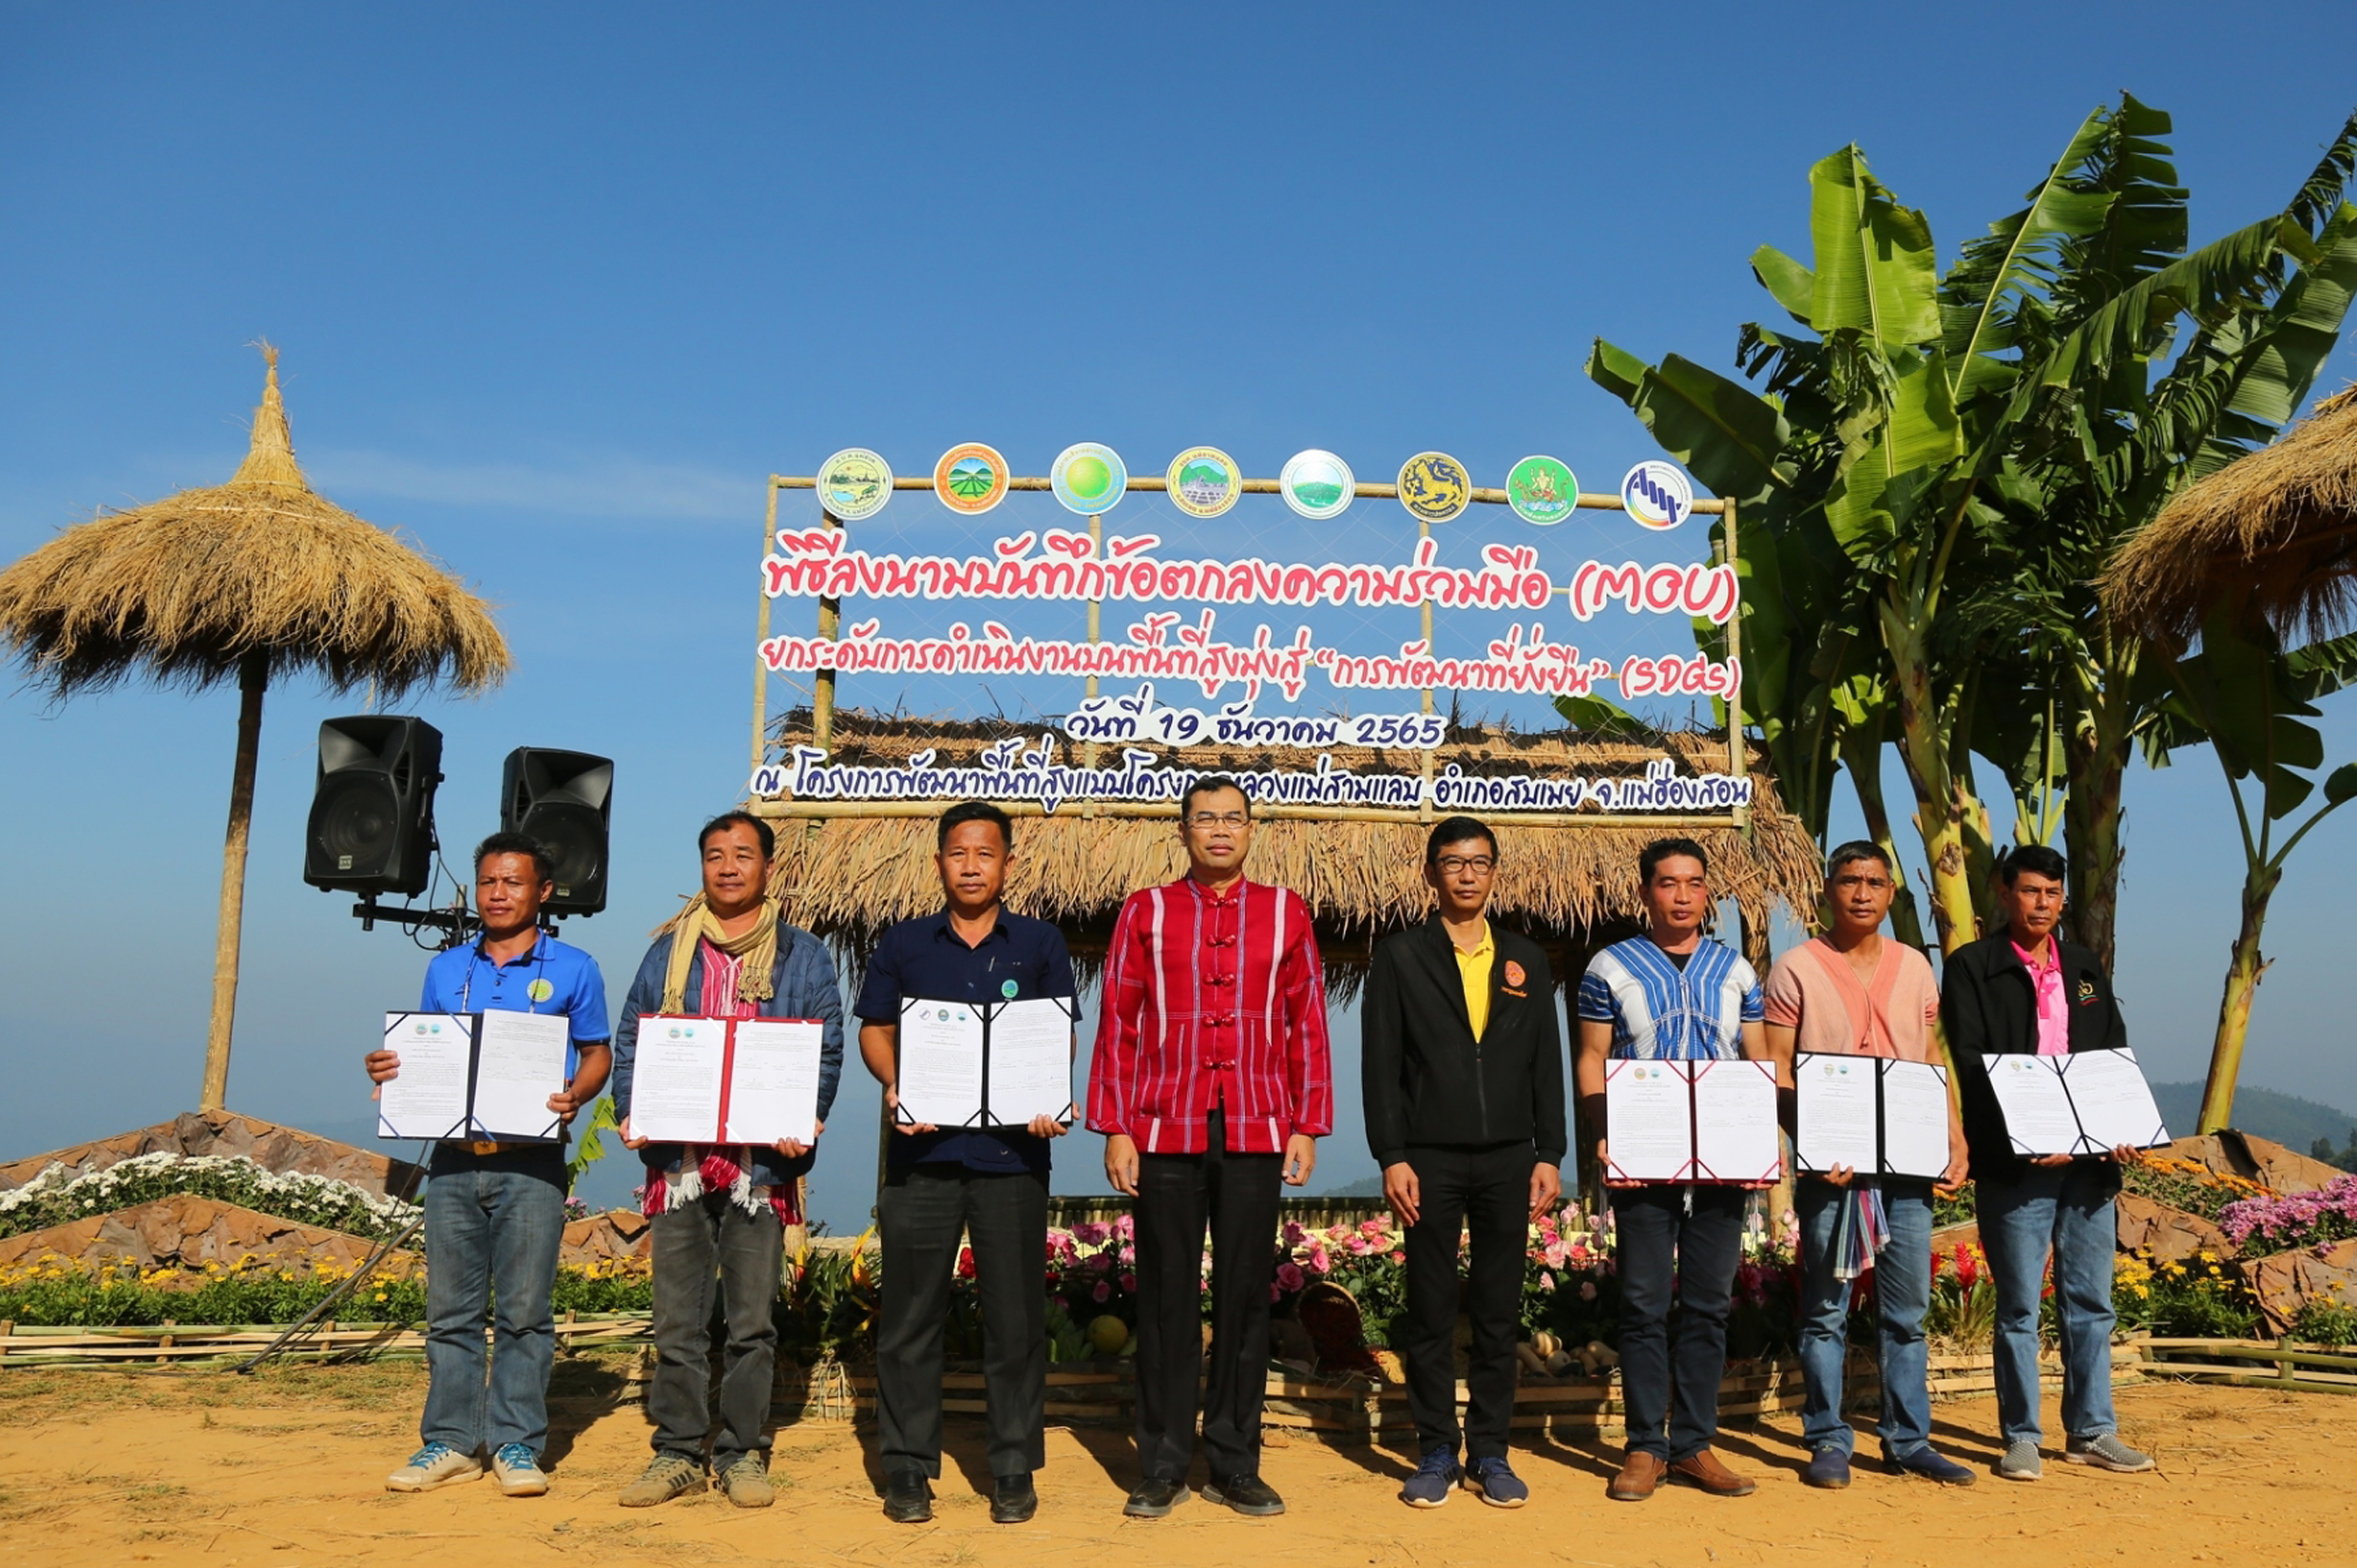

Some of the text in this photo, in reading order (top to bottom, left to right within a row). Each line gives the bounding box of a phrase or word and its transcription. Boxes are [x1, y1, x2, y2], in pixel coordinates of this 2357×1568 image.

[768, 533, 1736, 621] พิธีลงนามบันทึกข้อตกลงความร่วมมือ (MOU)
[763, 610, 1309, 699] ยกระดับการดำเนินงานบนพื้นที่สูงมุ่งสู่
[1620, 653, 1740, 700] (SDGs)
[1067, 684, 1441, 744] วันที่ 19 ธันวาคม 2565
[756, 769, 779, 793] ณ
[1435, 765, 1581, 807] อำเภอสบเมย
[1596, 763, 1747, 807] จ.แม่ฮ่องสอน
